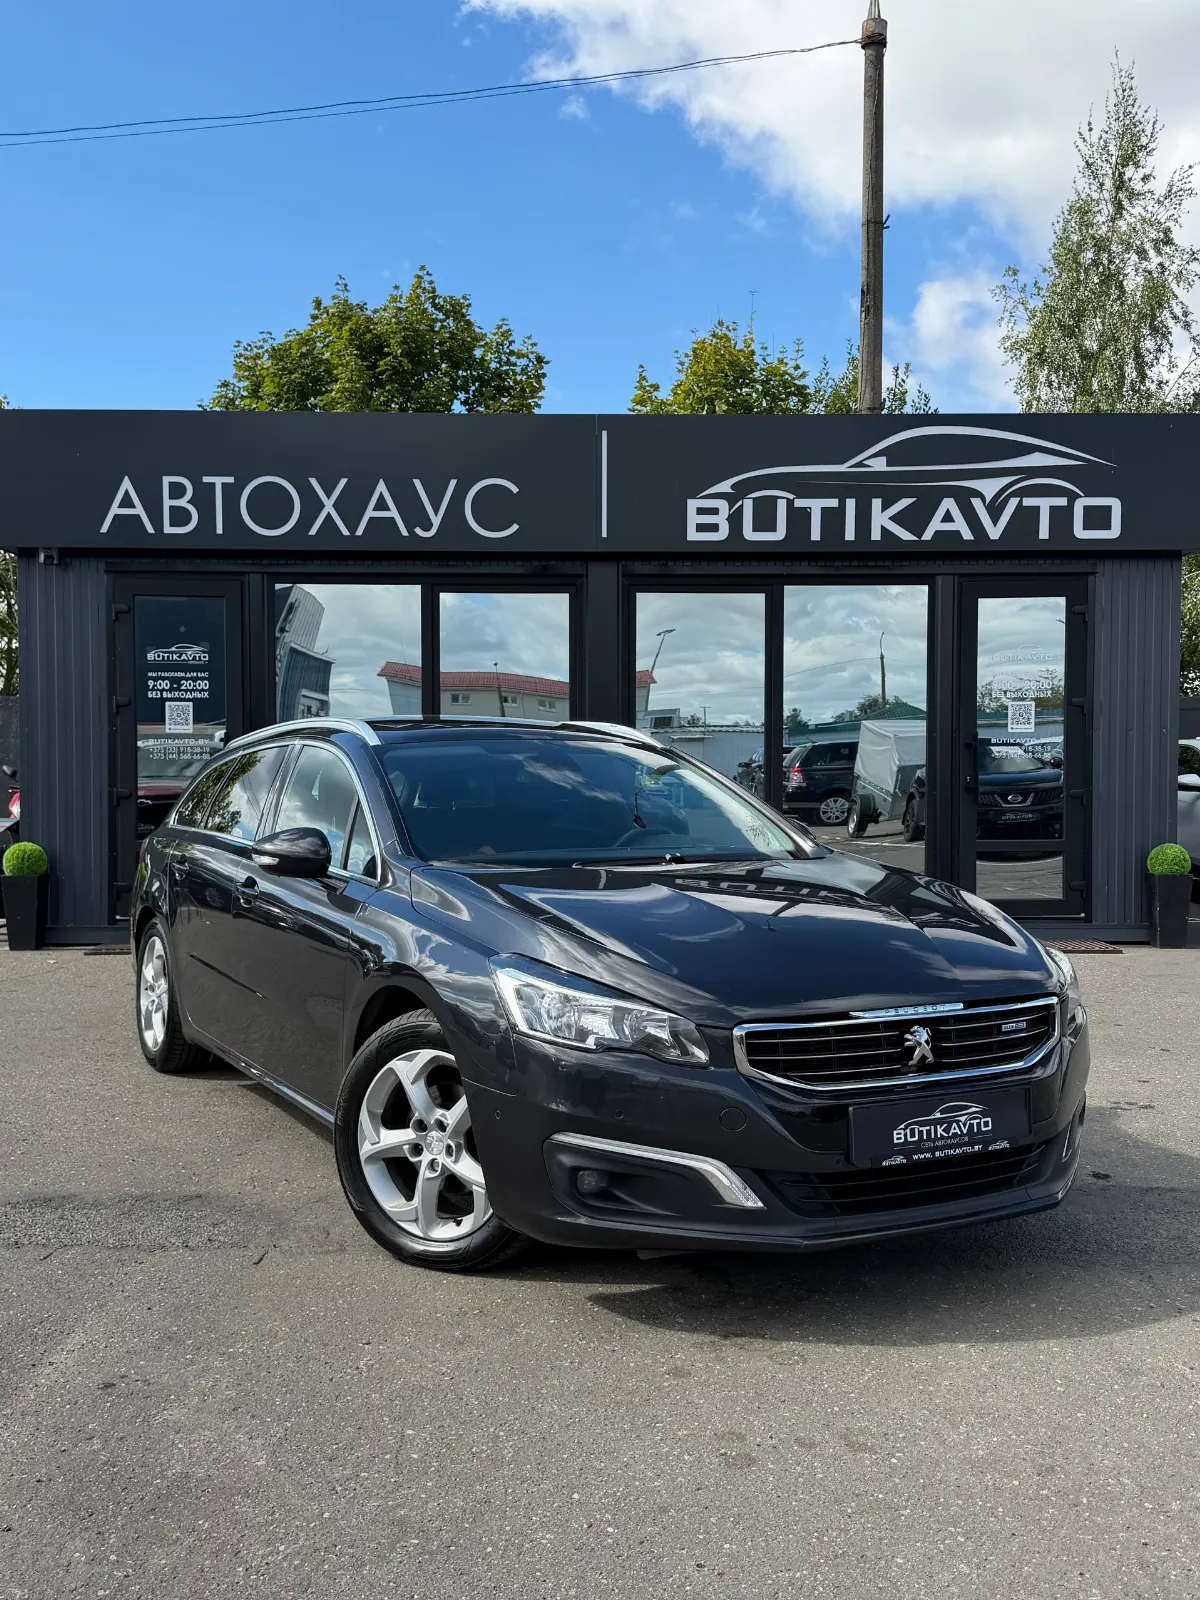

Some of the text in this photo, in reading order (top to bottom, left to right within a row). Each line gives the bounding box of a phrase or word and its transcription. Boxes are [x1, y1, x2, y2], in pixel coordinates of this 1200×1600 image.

[99, 475, 520, 539] АВТОХАУС
[686, 497, 1122, 542] BUTIKAVTO
[147, 653, 209, 661] BUTIKAVTO
[147, 680, 170, 690] 9:00
[180, 680, 209, 690] 20:00
[1024, 680, 1052, 689] 20:00
[162, 691, 209, 699] ВЫХОДНЫХ
[166, 746, 178, 754] (33)
[166, 752, 178, 760] (44)
[884, 1003, 946, 1014] PEUGEOT
[893, 1117, 992, 1143] BUTIKAVTO
[935, 1144, 983, 1158] BUTIKAVTO.BY
